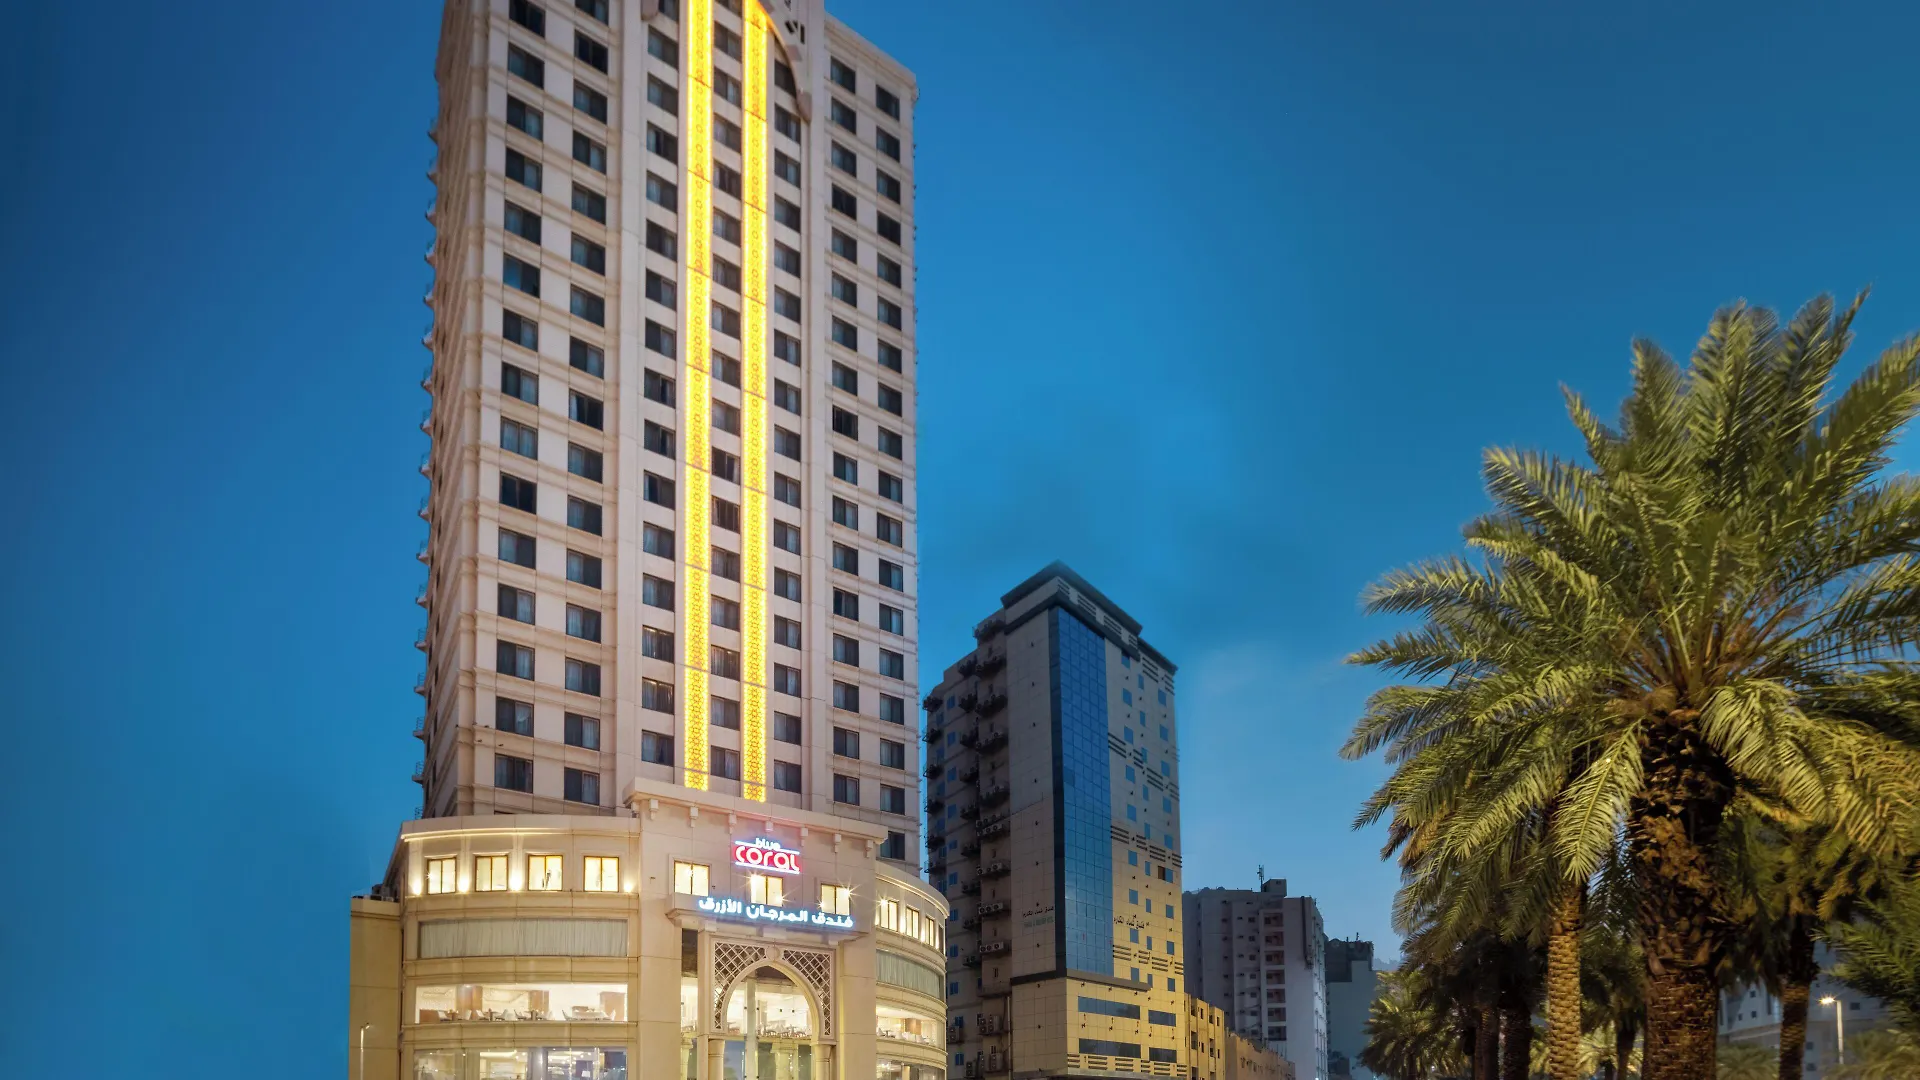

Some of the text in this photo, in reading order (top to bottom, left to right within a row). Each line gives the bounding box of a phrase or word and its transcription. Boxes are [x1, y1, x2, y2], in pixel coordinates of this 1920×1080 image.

[756, 837, 781, 850] blue
[735, 845, 800, 872] coral
[698, 897, 854, 928] فندق المرجان الأزرق
